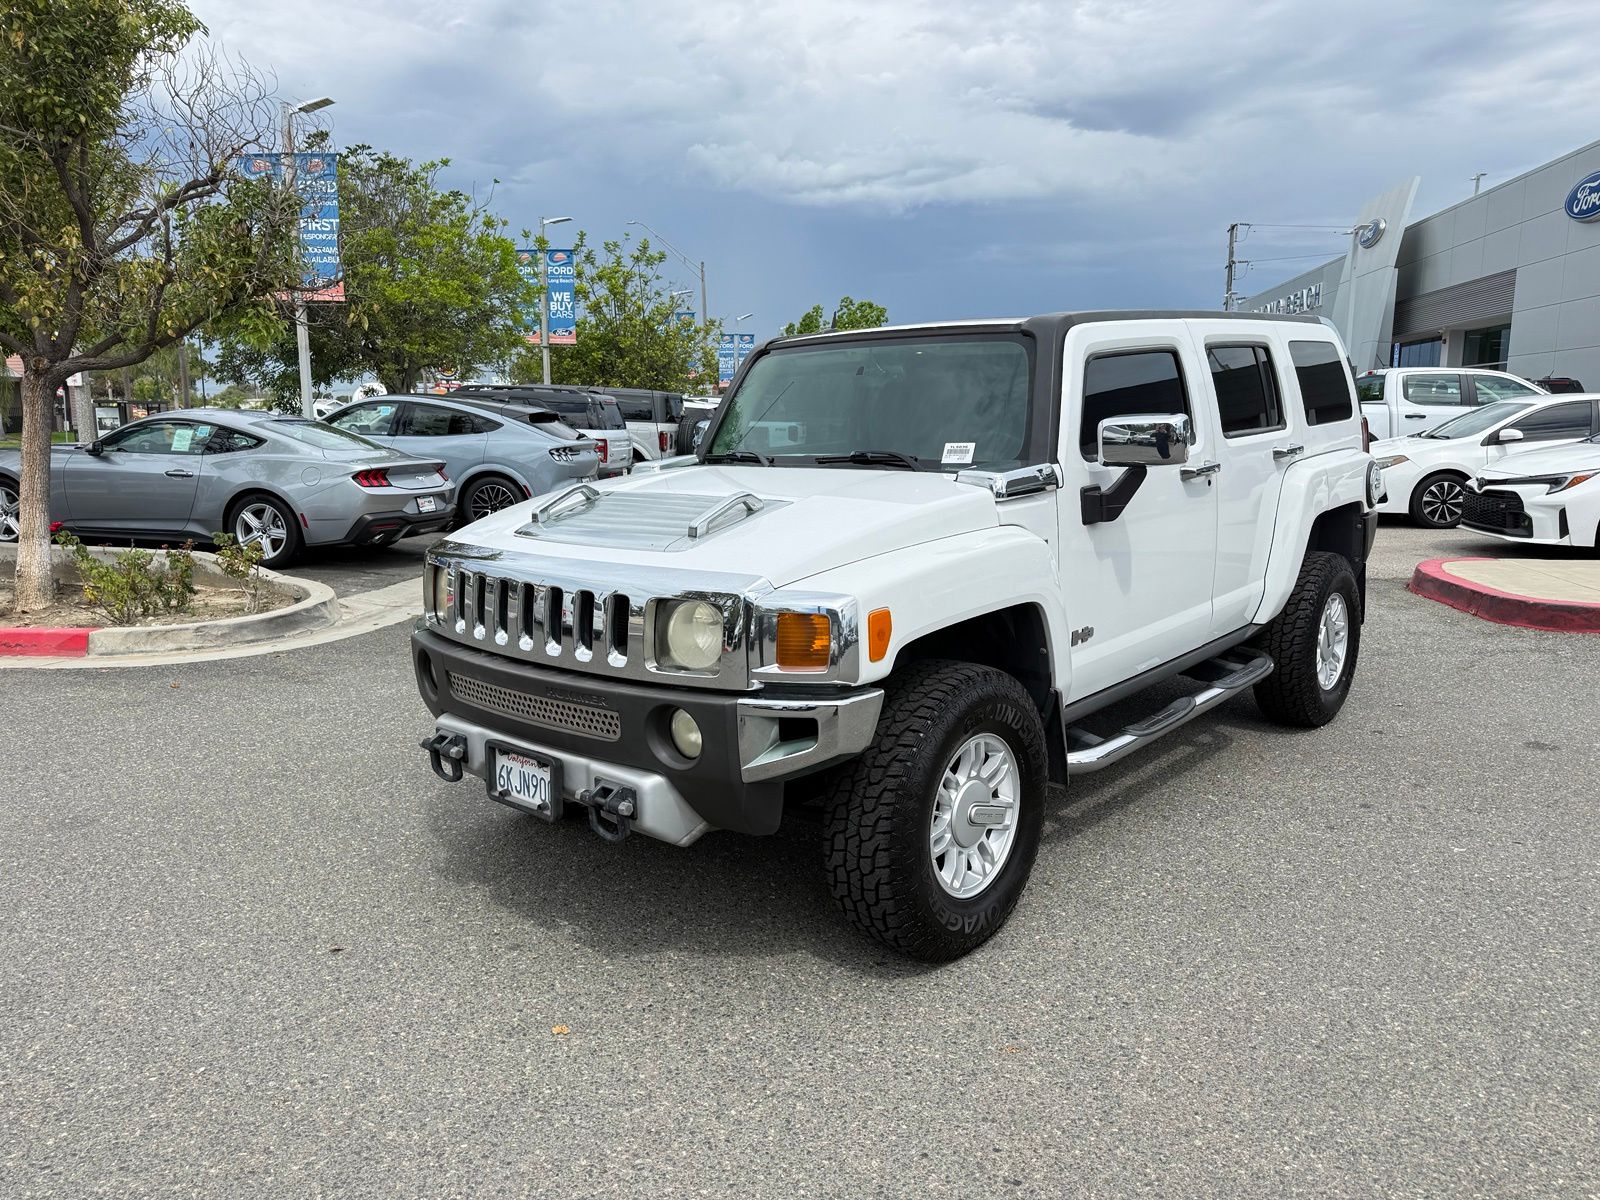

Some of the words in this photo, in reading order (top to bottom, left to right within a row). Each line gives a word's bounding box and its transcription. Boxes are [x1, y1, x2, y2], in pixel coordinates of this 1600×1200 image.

[300, 219, 339, 231] FIRST
[548, 266, 573, 275] FORD
[552, 291, 570, 302] WE
[1286, 282, 1323, 315] BEACH
[550, 301, 573, 311] BUY
[550, 310, 573, 319] CARS
